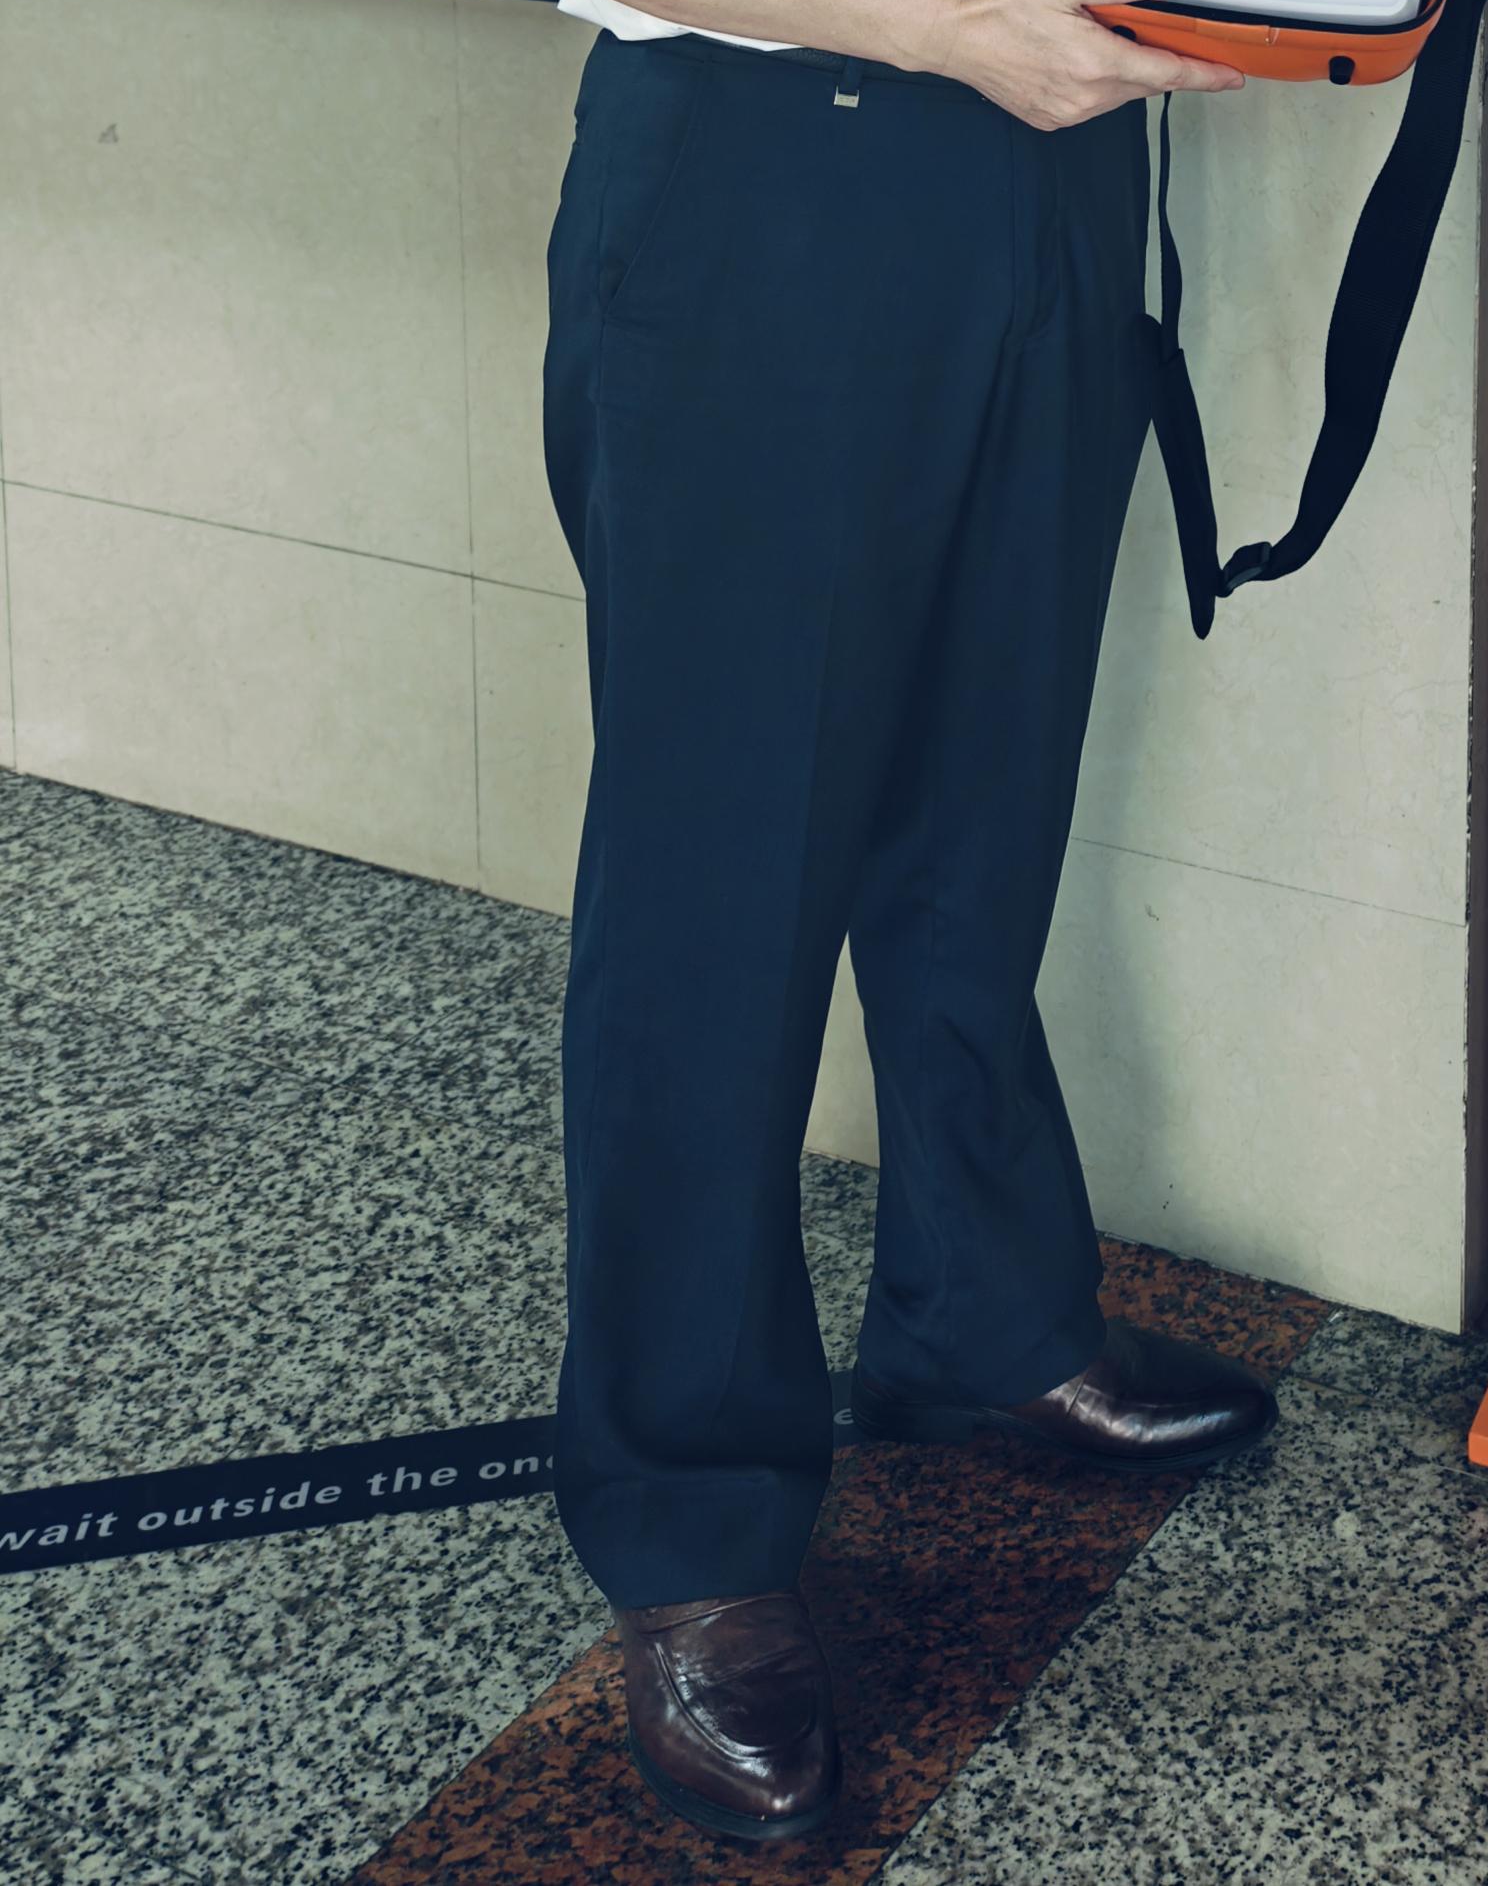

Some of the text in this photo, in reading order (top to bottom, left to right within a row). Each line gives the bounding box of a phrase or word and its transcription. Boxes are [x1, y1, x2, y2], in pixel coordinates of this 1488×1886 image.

[0, 1511, 118, 1551] wait
[137, 1480, 342, 1532] outside
[366, 1466, 458, 1497] the
